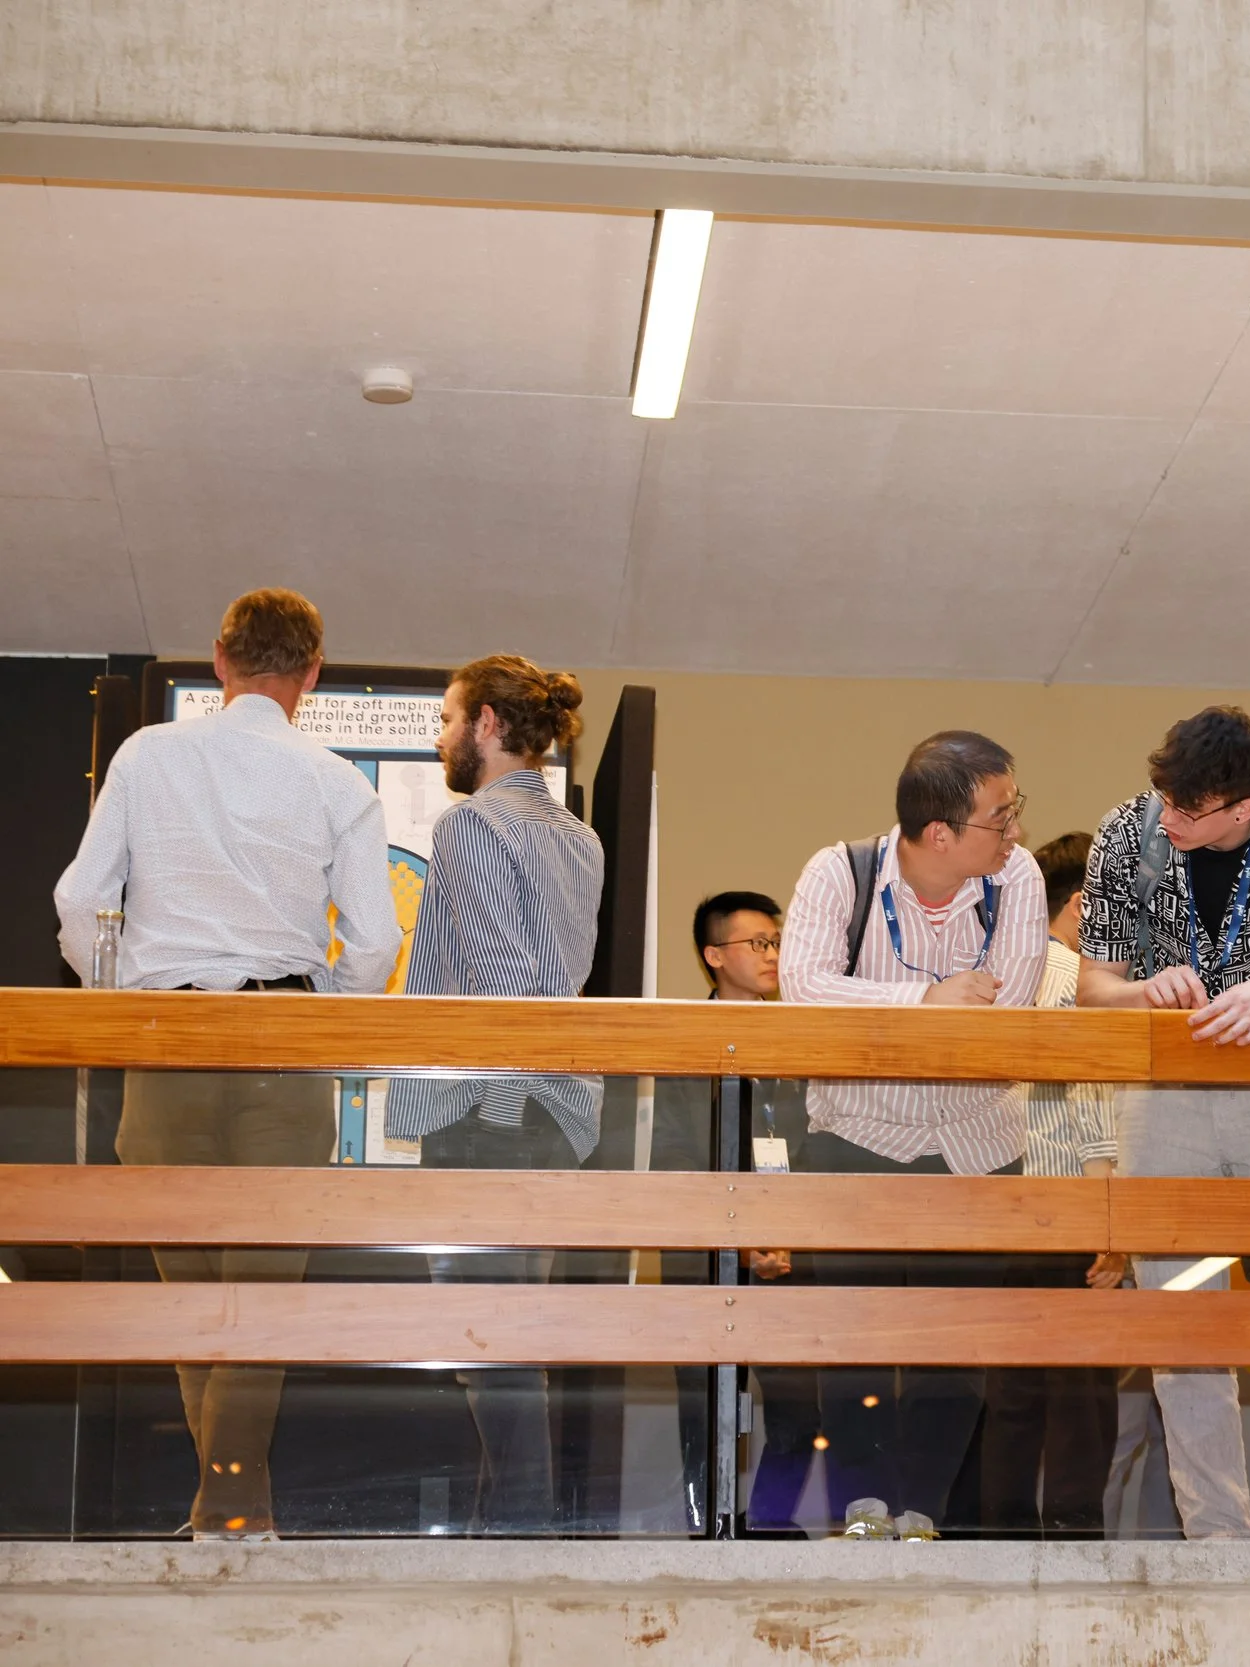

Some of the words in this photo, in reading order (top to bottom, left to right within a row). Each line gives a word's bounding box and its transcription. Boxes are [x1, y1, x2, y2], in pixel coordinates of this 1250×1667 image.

[185, 692, 195, 703] A
[201, 695, 220, 704] co
[325, 697, 347, 708] for
[352, 698, 383, 710] soft
[388, 699, 442, 714] imping
[292, 709, 365, 721] ontrolled
[370, 712, 426, 725] growth
[293, 720, 332, 733] icles
[338, 722, 352, 733] in
[358, 723, 383, 735] the
[388, 724, 427, 736] solid
